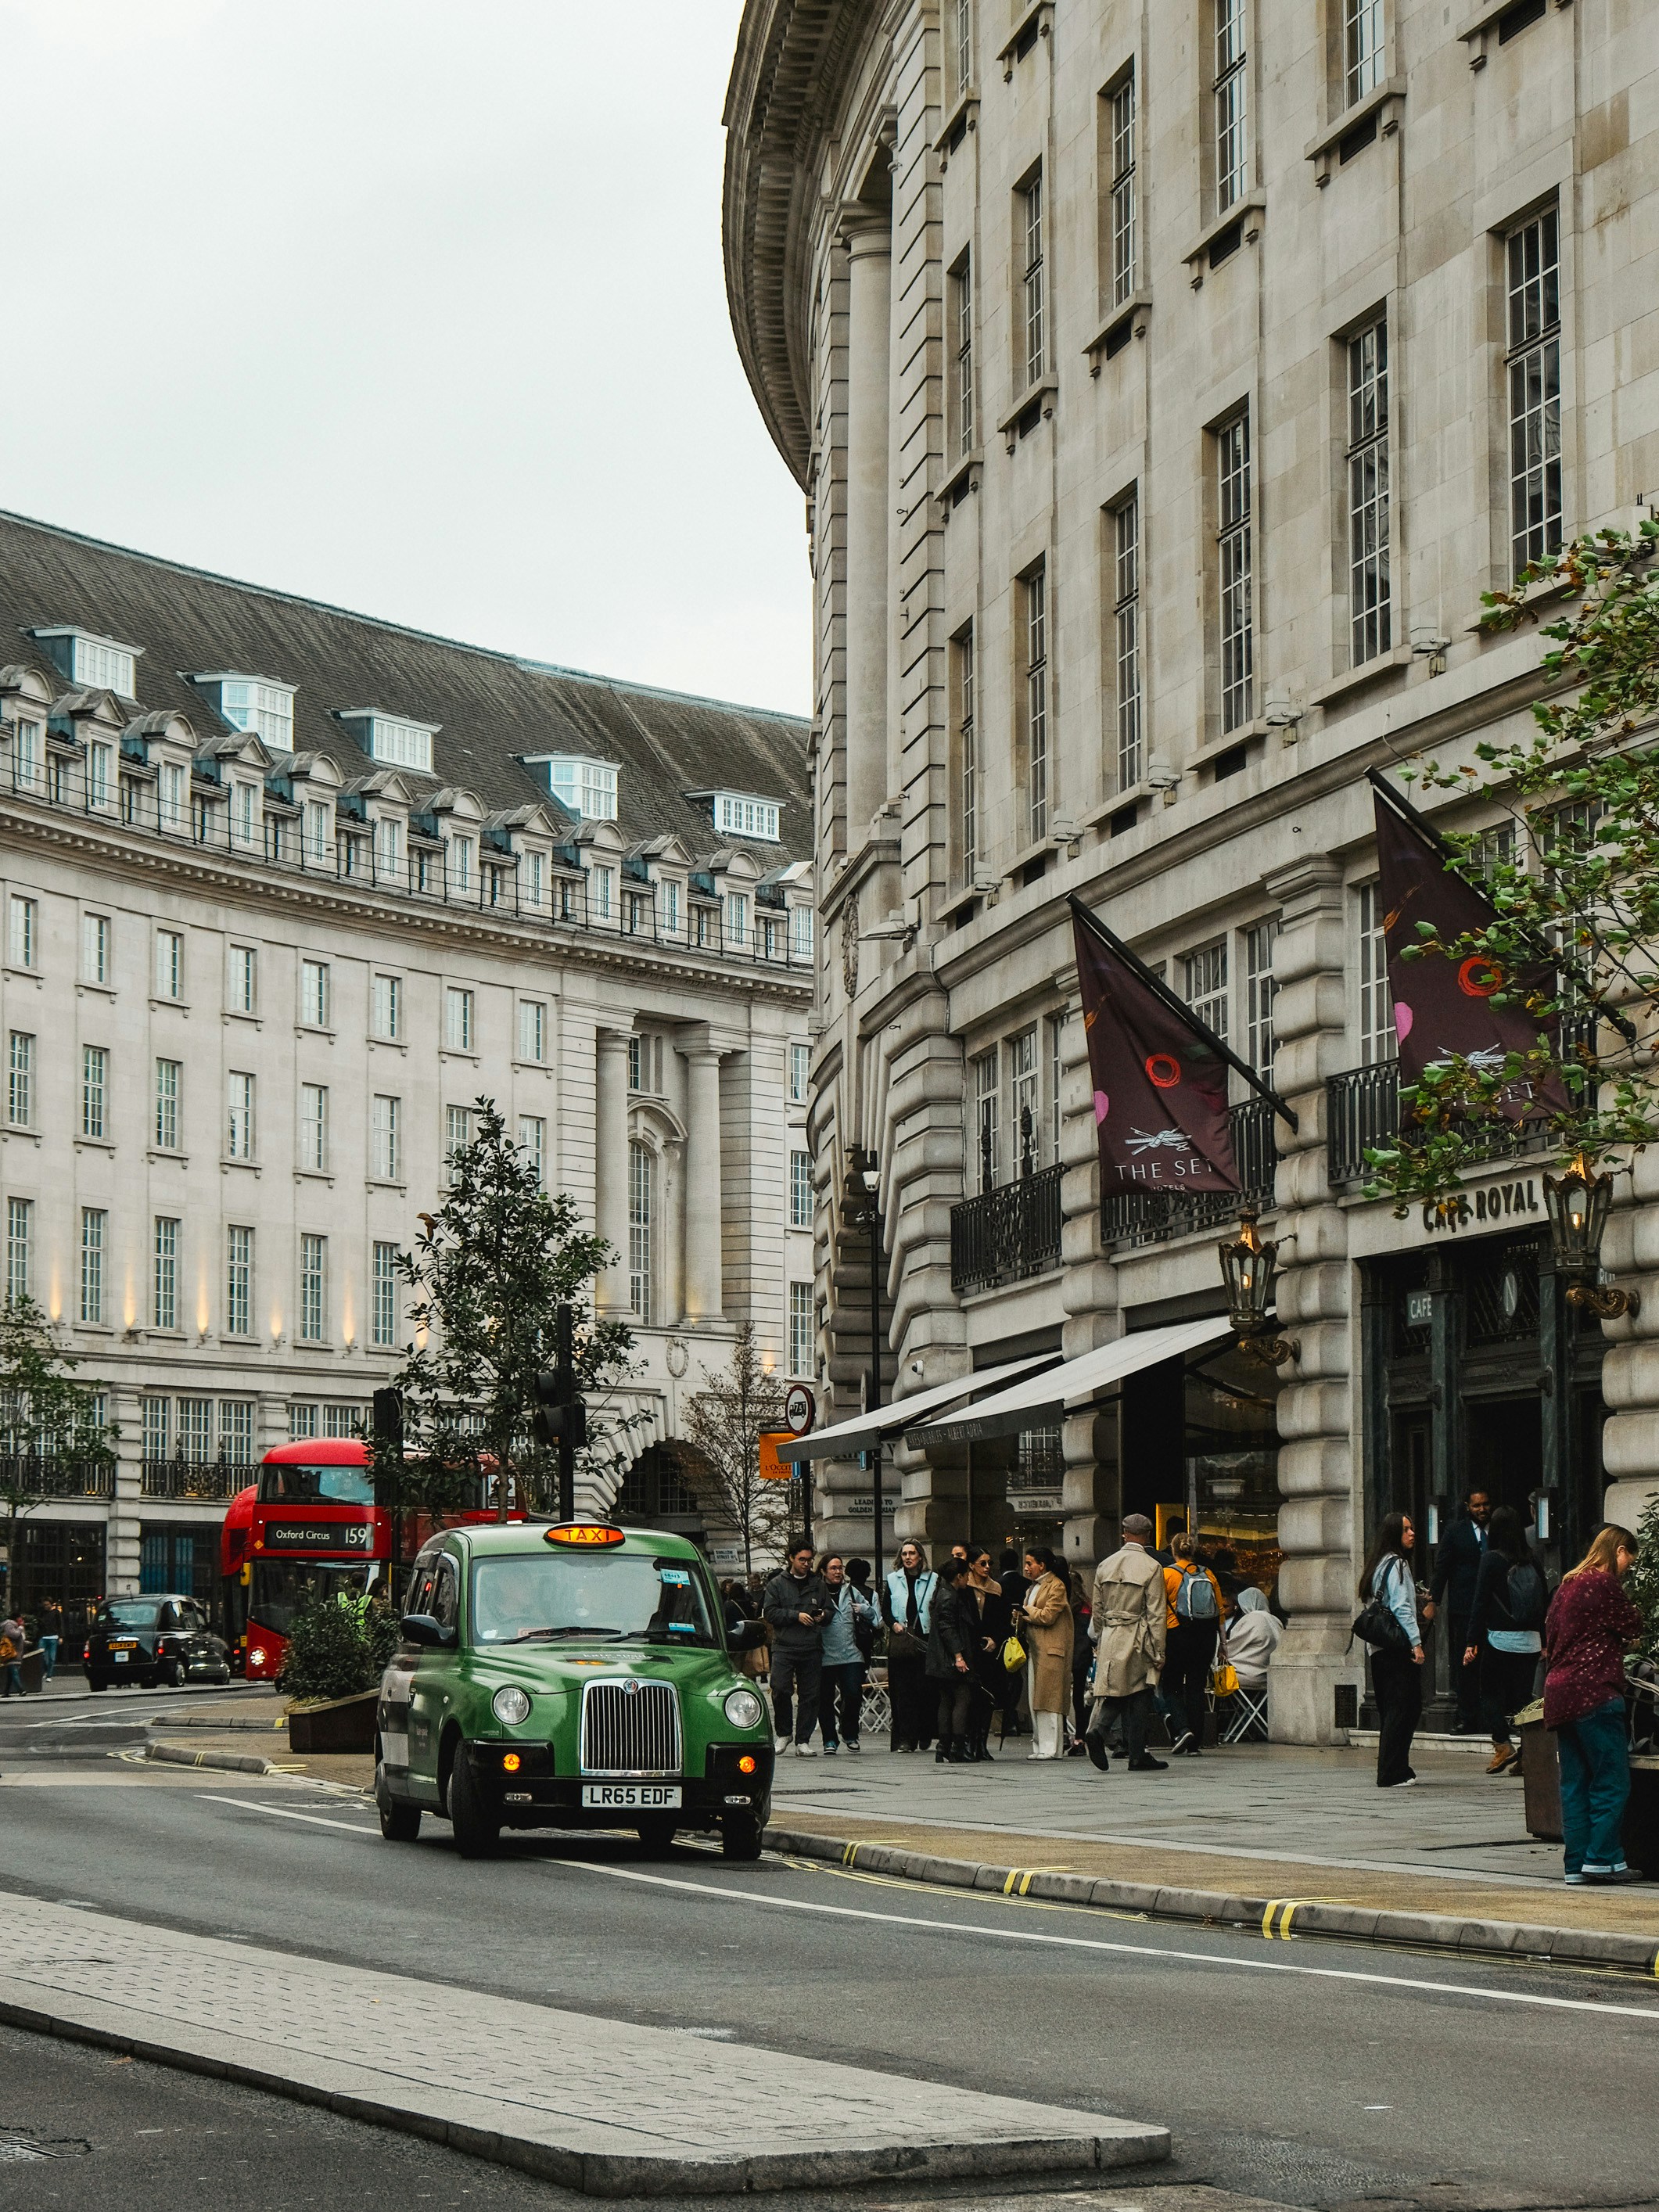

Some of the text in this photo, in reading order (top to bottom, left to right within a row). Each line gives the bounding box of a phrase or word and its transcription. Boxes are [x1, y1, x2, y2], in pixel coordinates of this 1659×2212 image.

[1115, 1162, 1162, 1180] THE
[1151, 1183, 1186, 1192] OTELS
[1476, 1180, 1539, 1219] ROYAL
[276, 1529, 330, 1540] Oxford Circus
[345, 1528, 367, 1544] 159
[564, 1529, 610, 1542] TAXI
[590, 1787, 674, 1804] LR65 EDF
